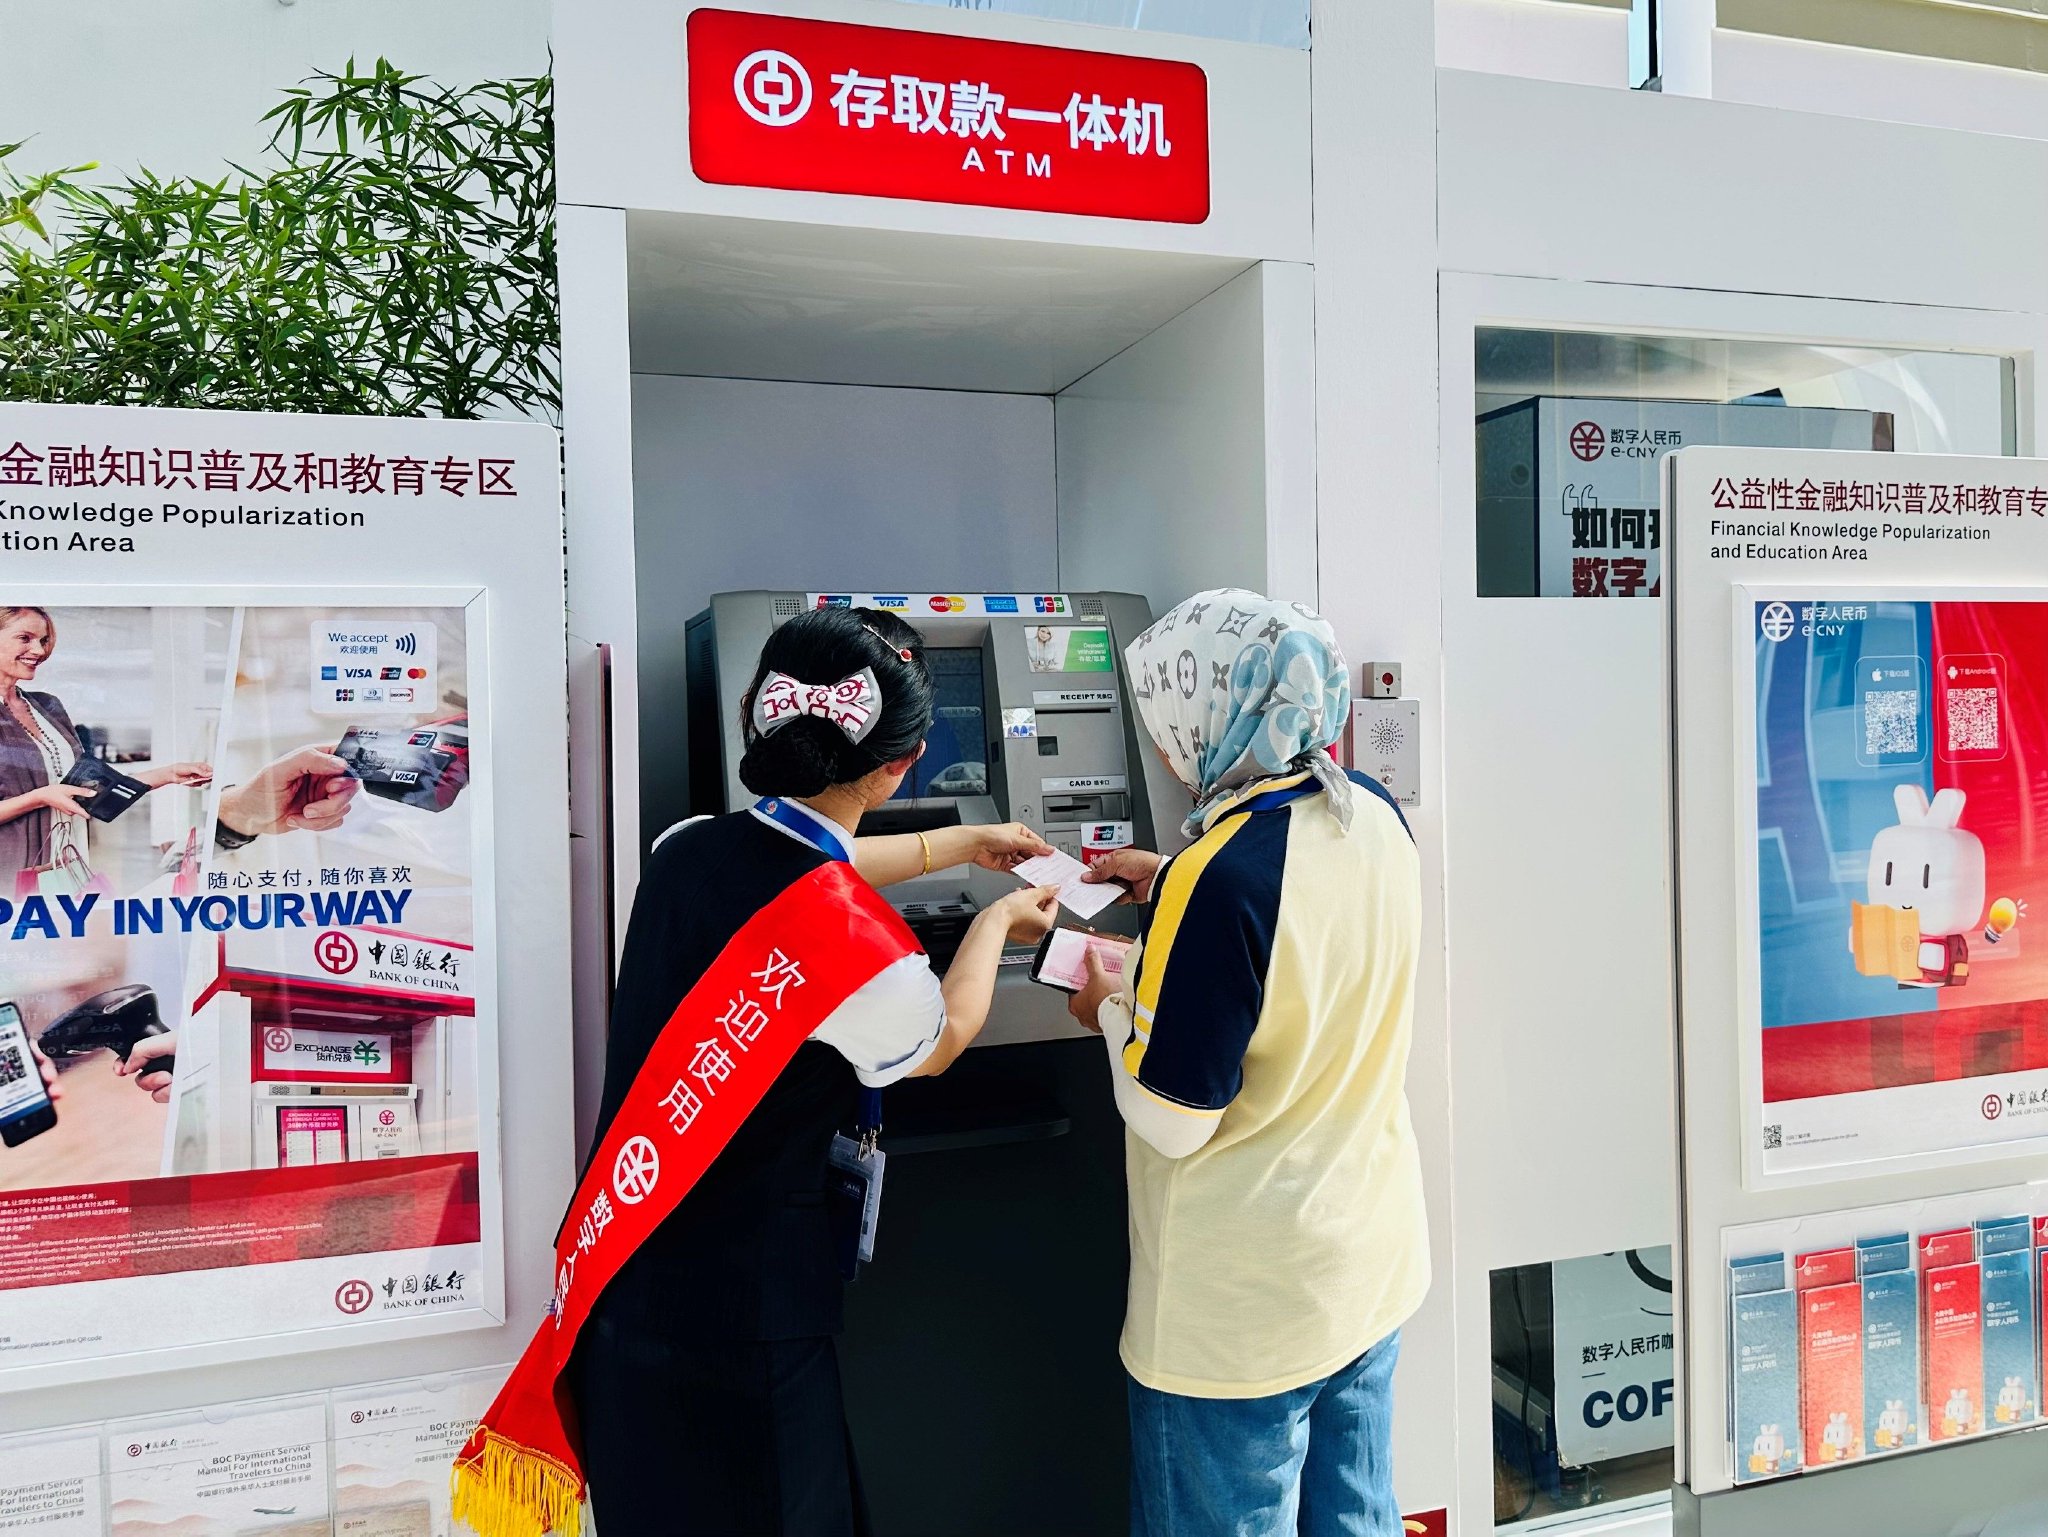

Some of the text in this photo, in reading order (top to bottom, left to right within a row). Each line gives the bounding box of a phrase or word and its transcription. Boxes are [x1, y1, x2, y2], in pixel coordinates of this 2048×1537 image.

[830, 68, 1171, 158] 存取款一体机
[962, 147, 1051, 178] ATM
[1610, 428, 1682, 445] 数字人民币
[1611, 447, 1657, 458] e-CNY
[0, 441, 517, 497] 金融知识普及和教育专区
[1710, 477, 2048, 517] 公益性金融知识普及和教育专
[163, 504, 364, 528] Popularization
[1711, 520, 1991, 541] Financial Knowledge Popularization
[68, 532, 135, 552] Area
[1711, 544, 1868, 560] and Education Area
[1572, 557, 1660, 597] 数字
[878, 600, 905, 608] VISA
[930, 600, 966, 608] MasterCard
[1035, 598, 1064, 610] JCB
[1802, 605, 1867, 621] 数字人民币
[328, 633, 389, 645] We accept
[1802, 624, 1845, 637] e-CNY
[340, 645, 378, 655] 欢迎使用
[344, 668, 373, 678] VISA
[394, 772, 416, 782] VISA
[208, 865, 412, 890] 随心支付，随你喜欢
[114, 898, 163, 935] IN
[169, 892, 307, 932] YOUR
[310, 889, 412, 927] WAY
[369, 969, 460, 991] BANK OF CHINA
[294, 1043, 352, 1054] EXCHANGE
[657, 947, 807, 1136] 欢迎使用
[383, 1294, 465, 1310] BANK OF CHINA
[1582, 1378, 1673, 1429] COF
[415, 1430, 448, 1442] Manual
[450, 1429, 463, 1437] For
[429, 1419, 482, 1432] BOC Payme
[197, 1452, 312, 1476] Manual For International
[212, 1444, 311, 1465] BOC Payment Service
[229, 1461, 312, 1481] Travelers to China
[0, 1479, 84, 1497] Payment Service
[18, 1485, 84, 1503] International
[0, 1495, 84, 1515] ravelers to China
